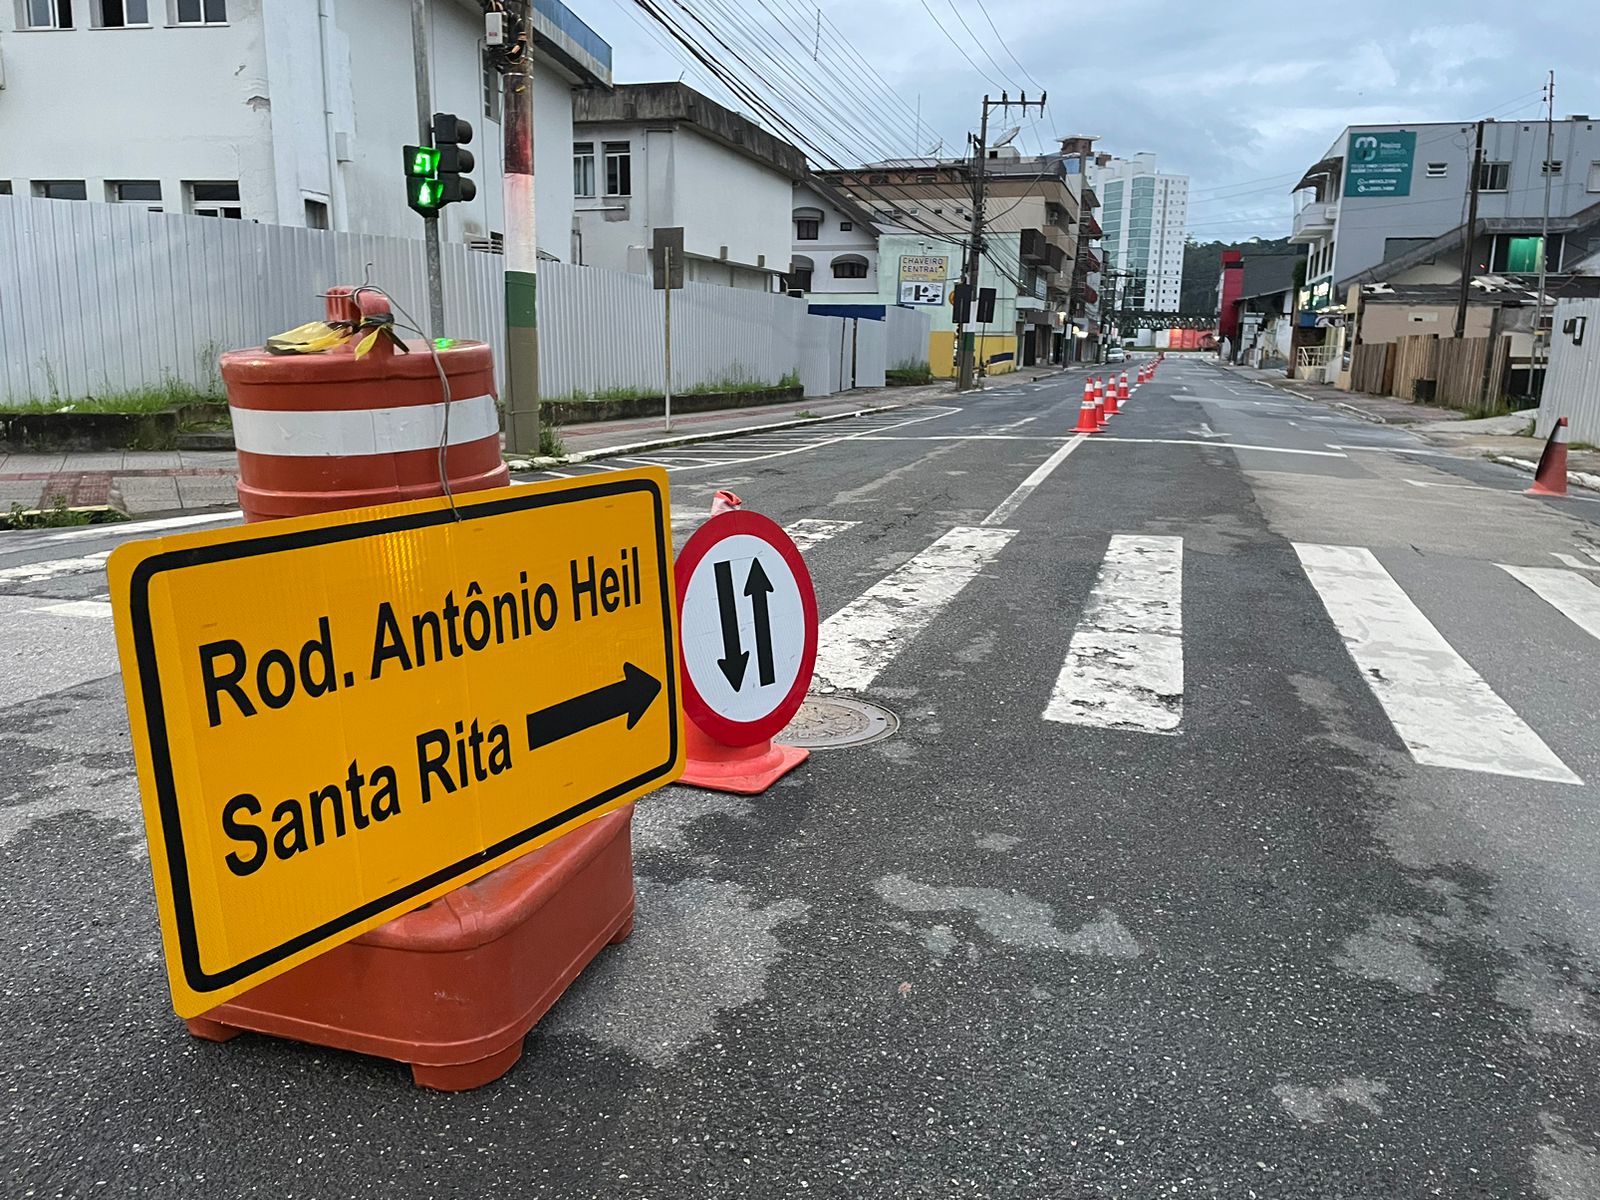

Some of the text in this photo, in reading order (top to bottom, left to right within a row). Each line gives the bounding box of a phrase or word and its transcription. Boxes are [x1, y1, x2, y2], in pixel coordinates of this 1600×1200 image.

[902, 257, 943, 265] CHAVEIRO
[902, 265, 938, 273] CENTRAL
[199, 547, 641, 728] Rod. Antônio Heil
[222, 717, 513, 877] Santa Rita
